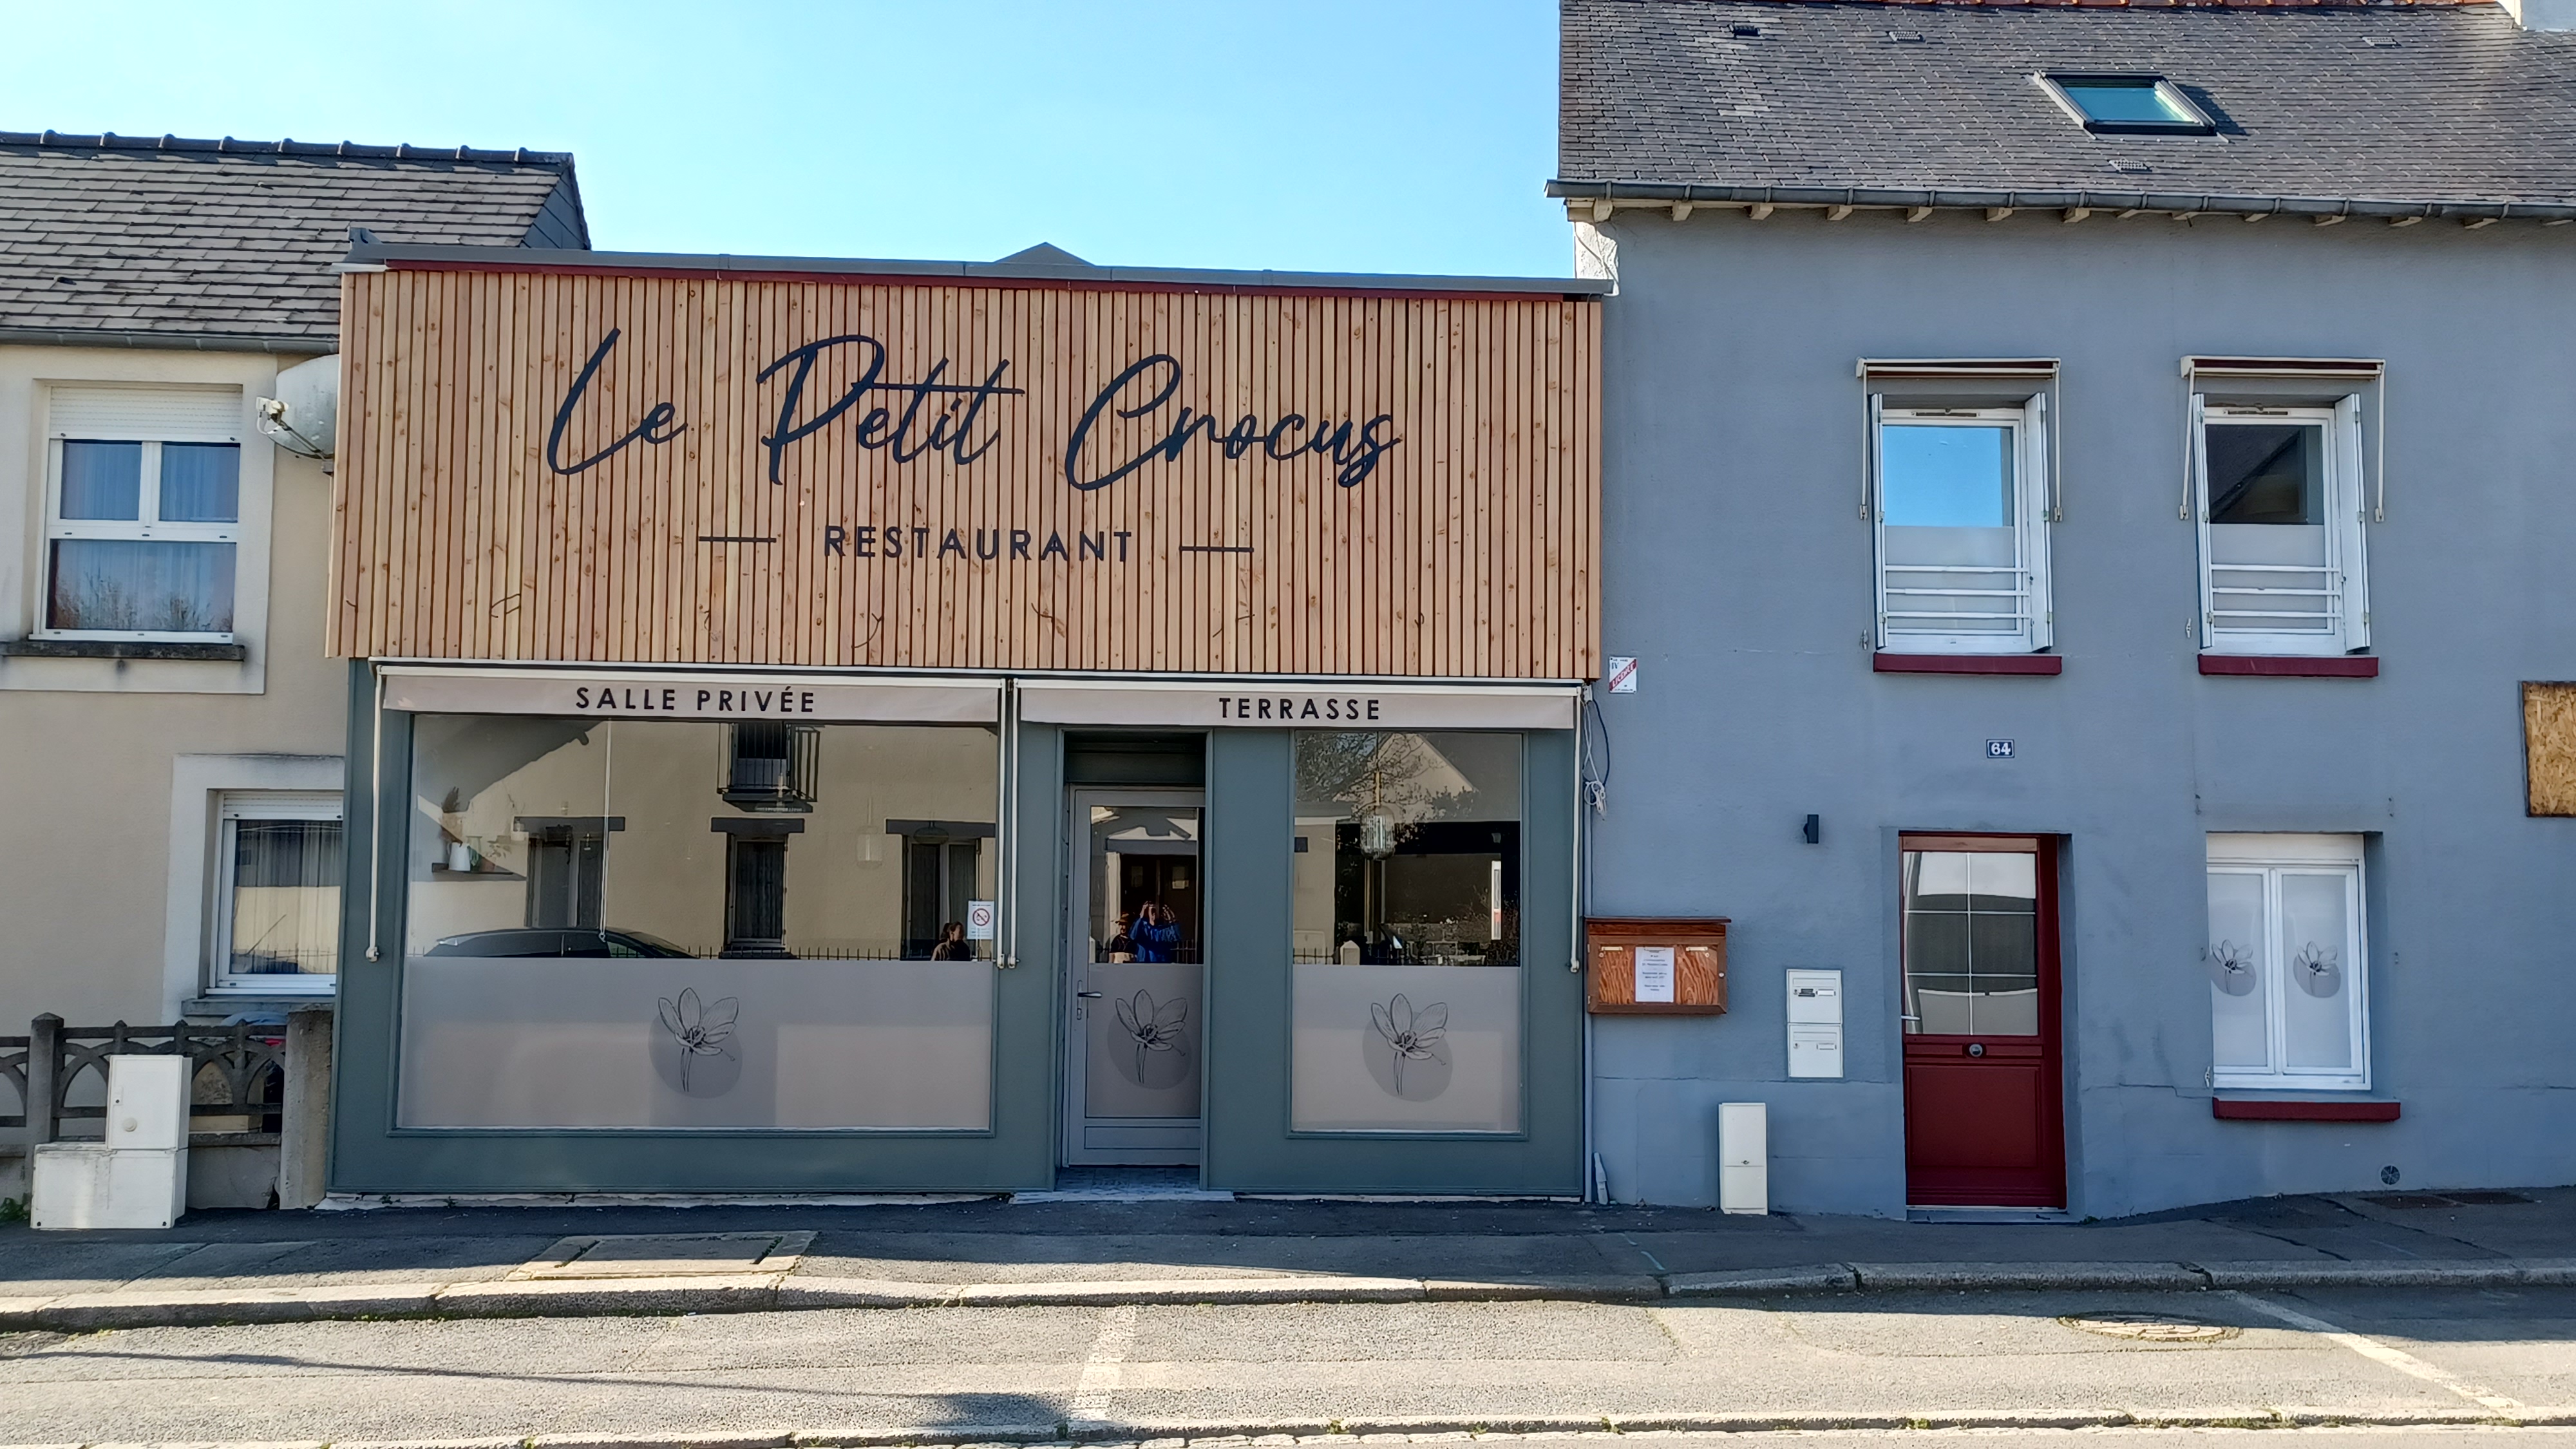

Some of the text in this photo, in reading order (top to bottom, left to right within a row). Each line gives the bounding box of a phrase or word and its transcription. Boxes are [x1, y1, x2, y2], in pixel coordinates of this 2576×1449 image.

[546, 328, 1403, 491] Le Petit Crocus
[824, 525, 1132, 562] RESTAURANT
[575, 686, 815, 713] SALLE PRIVÉE
[1219, 697, 1379, 721] TERRASSE
[1991, 742, 2011, 755] 64
